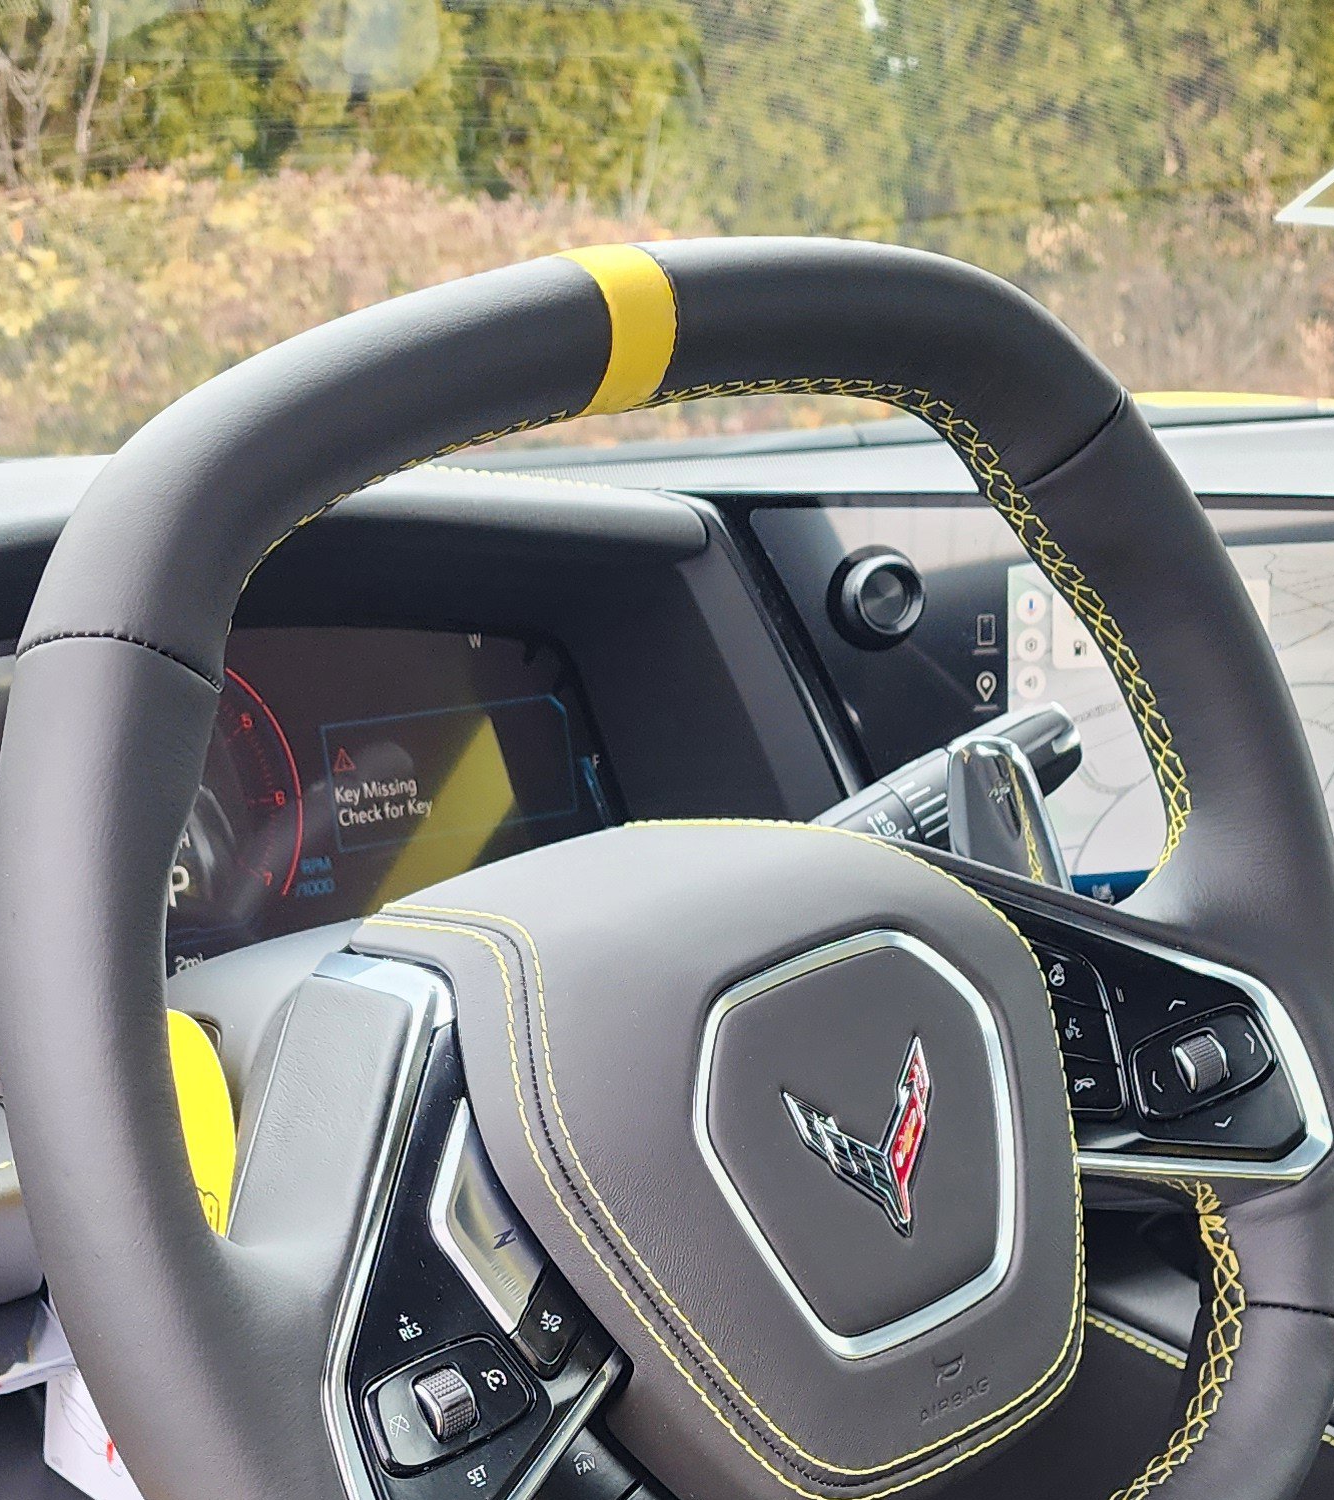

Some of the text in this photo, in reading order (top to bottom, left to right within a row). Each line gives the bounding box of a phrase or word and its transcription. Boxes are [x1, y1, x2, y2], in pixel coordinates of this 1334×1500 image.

[467, 632, 482, 649] W
[334, 777, 417, 806] Key Missing
[337, 798, 434, 828] Check for Key
[398, 1322, 423, 1342] RES
[919, 1376, 990, 1424] AIRBAG
[466, 1463, 488, 1485] SET
[574, 1456, 597, 1476] FAV
